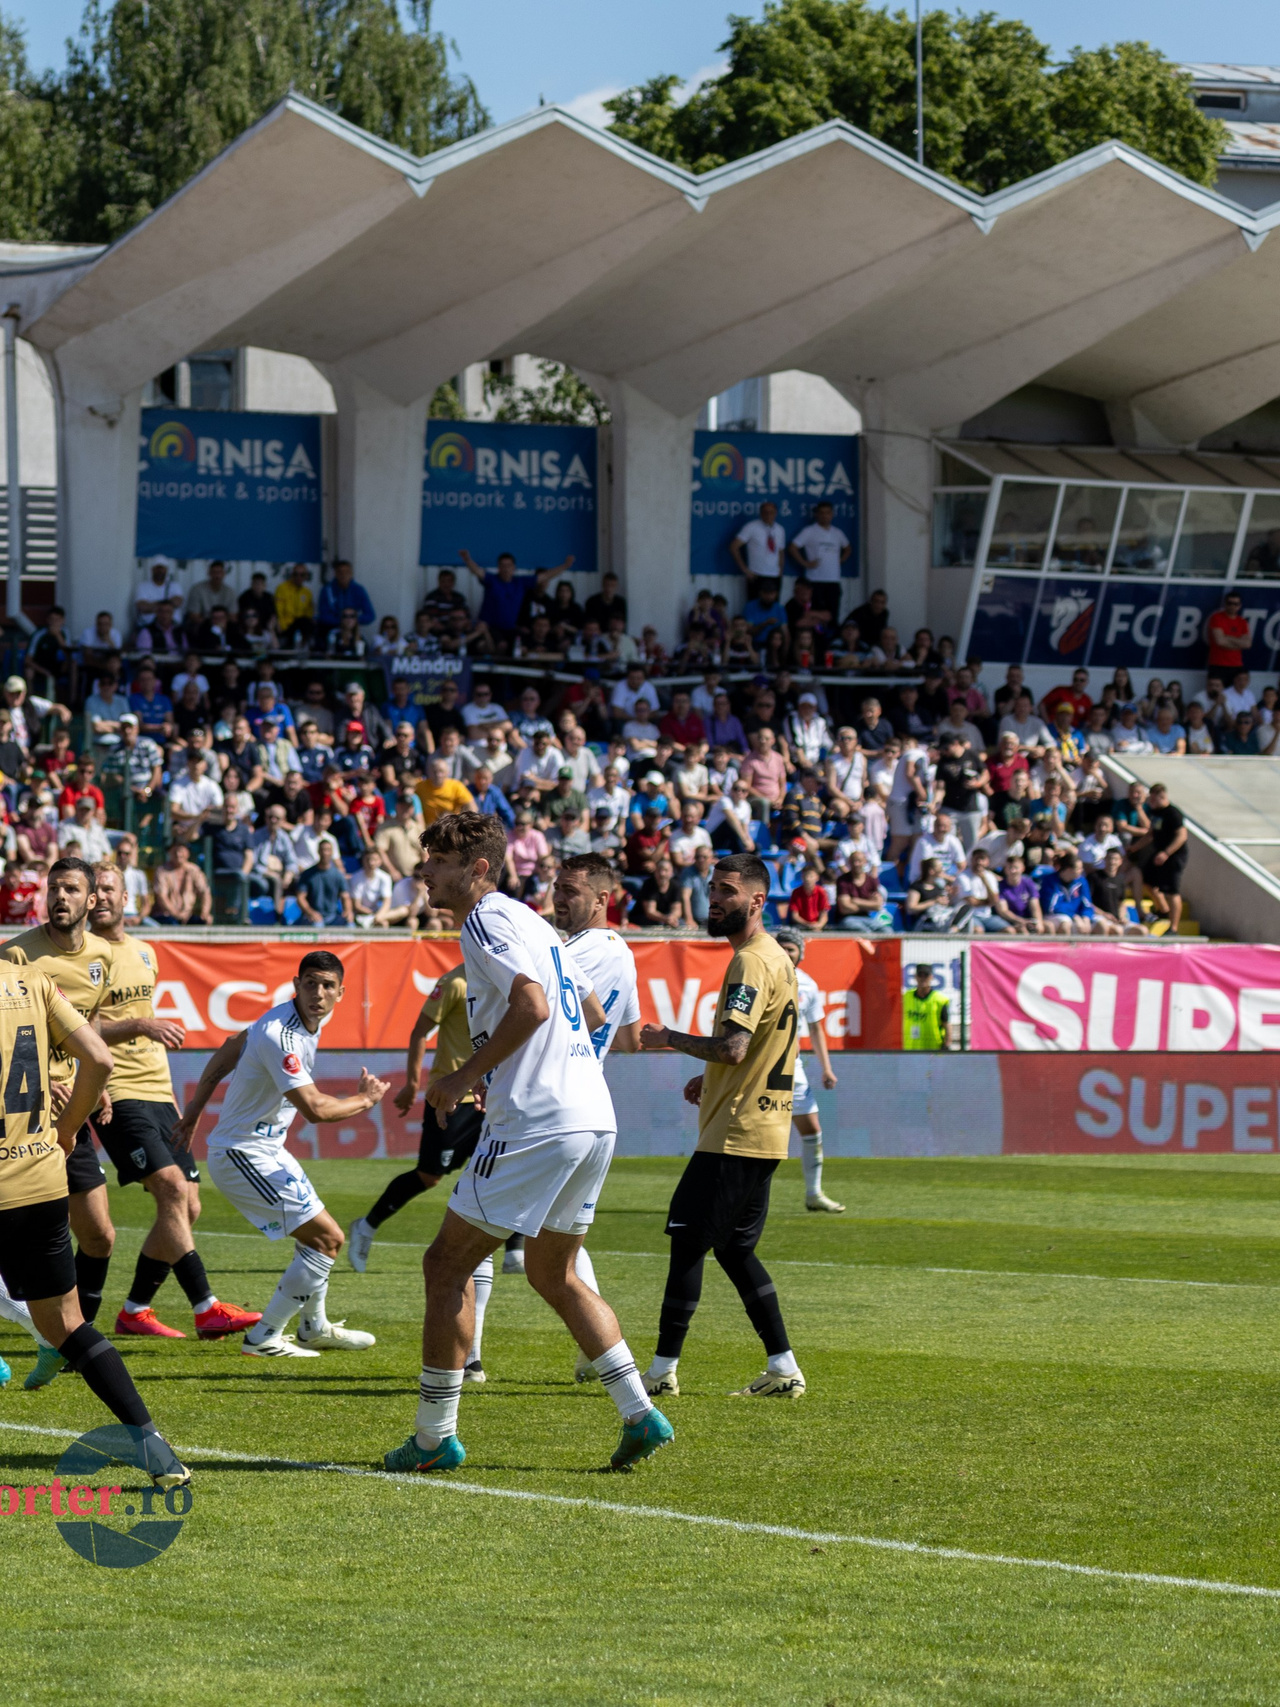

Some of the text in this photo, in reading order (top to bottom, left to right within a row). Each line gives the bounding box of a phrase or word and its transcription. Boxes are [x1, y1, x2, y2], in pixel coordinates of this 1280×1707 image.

[257, 484, 318, 503] sports
[534, 495, 593, 513] sports
[801, 501, 855, 518] sprts
[1105, 604, 1164, 648] FC
[550, 946, 581, 1031] 6
